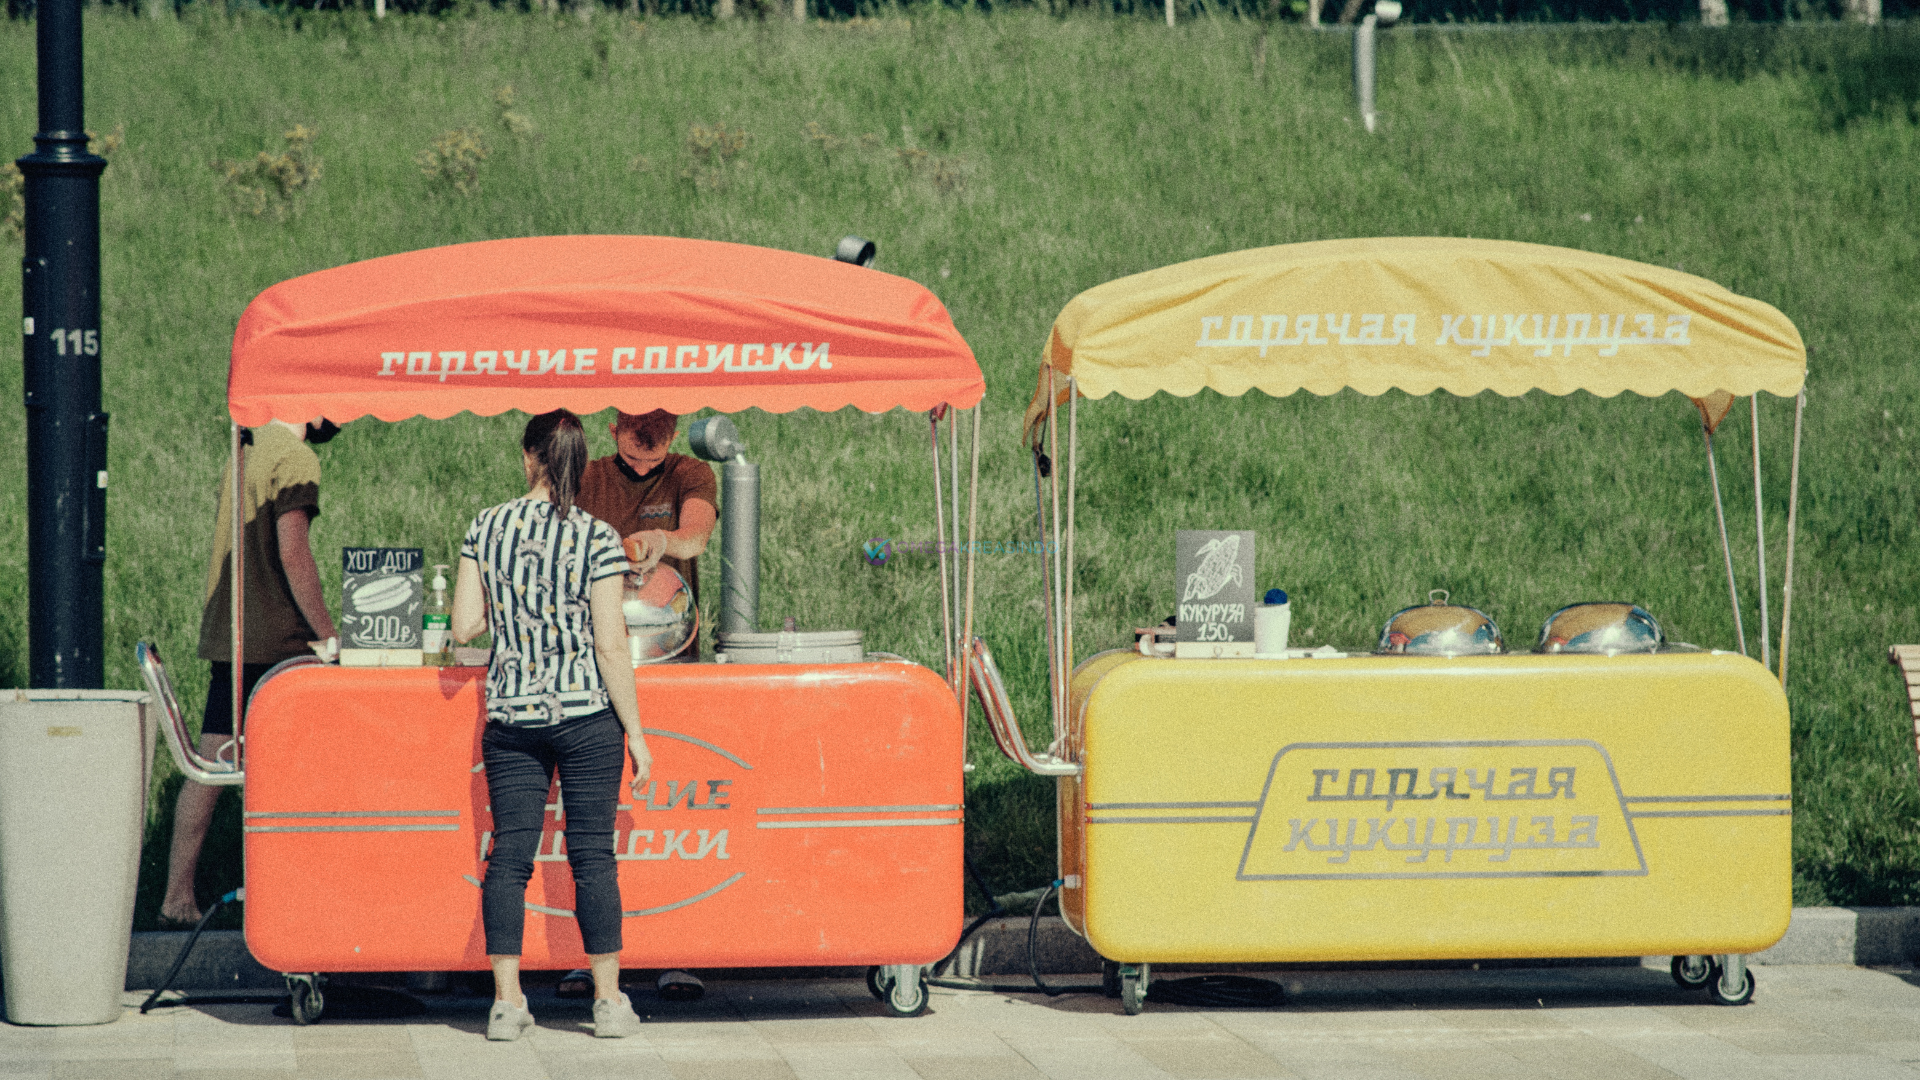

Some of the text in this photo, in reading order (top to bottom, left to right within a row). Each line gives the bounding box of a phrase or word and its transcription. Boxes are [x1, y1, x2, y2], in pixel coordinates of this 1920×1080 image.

[50, 328, 98, 356] 115
[347, 550, 419, 574] ХОТ ДОГ
[1179, 603, 1245, 623] КУКУРУЗА
